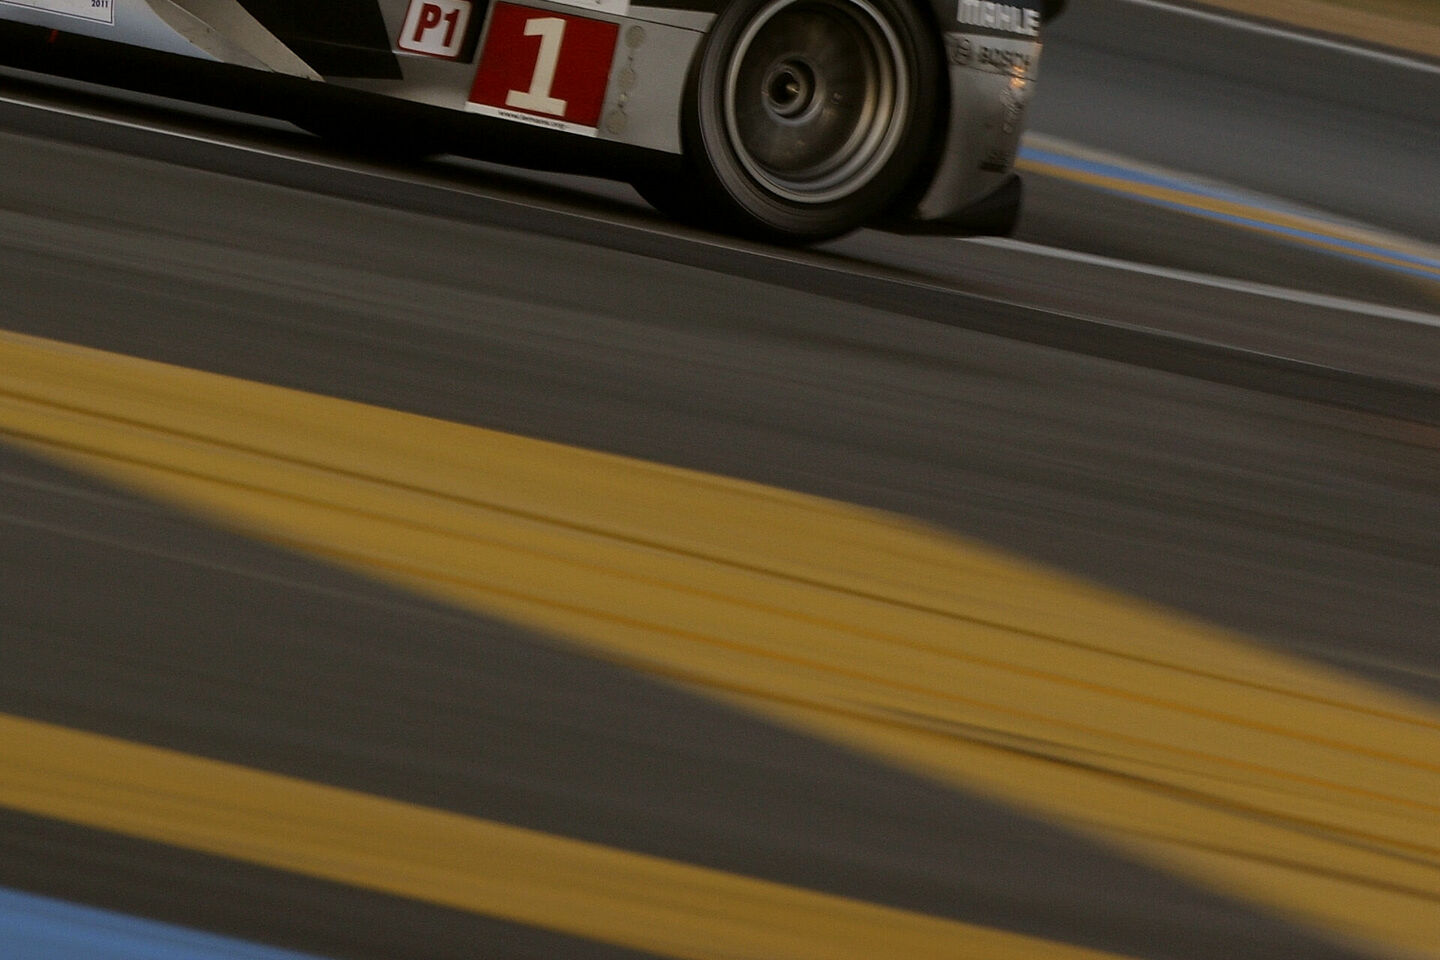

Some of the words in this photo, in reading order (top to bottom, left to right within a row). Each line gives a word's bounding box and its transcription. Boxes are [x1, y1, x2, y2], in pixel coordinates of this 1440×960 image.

[91, 0, 109, 8] 2011
[414, 3, 460, 48] P1
[505, 17, 568, 117] 1
